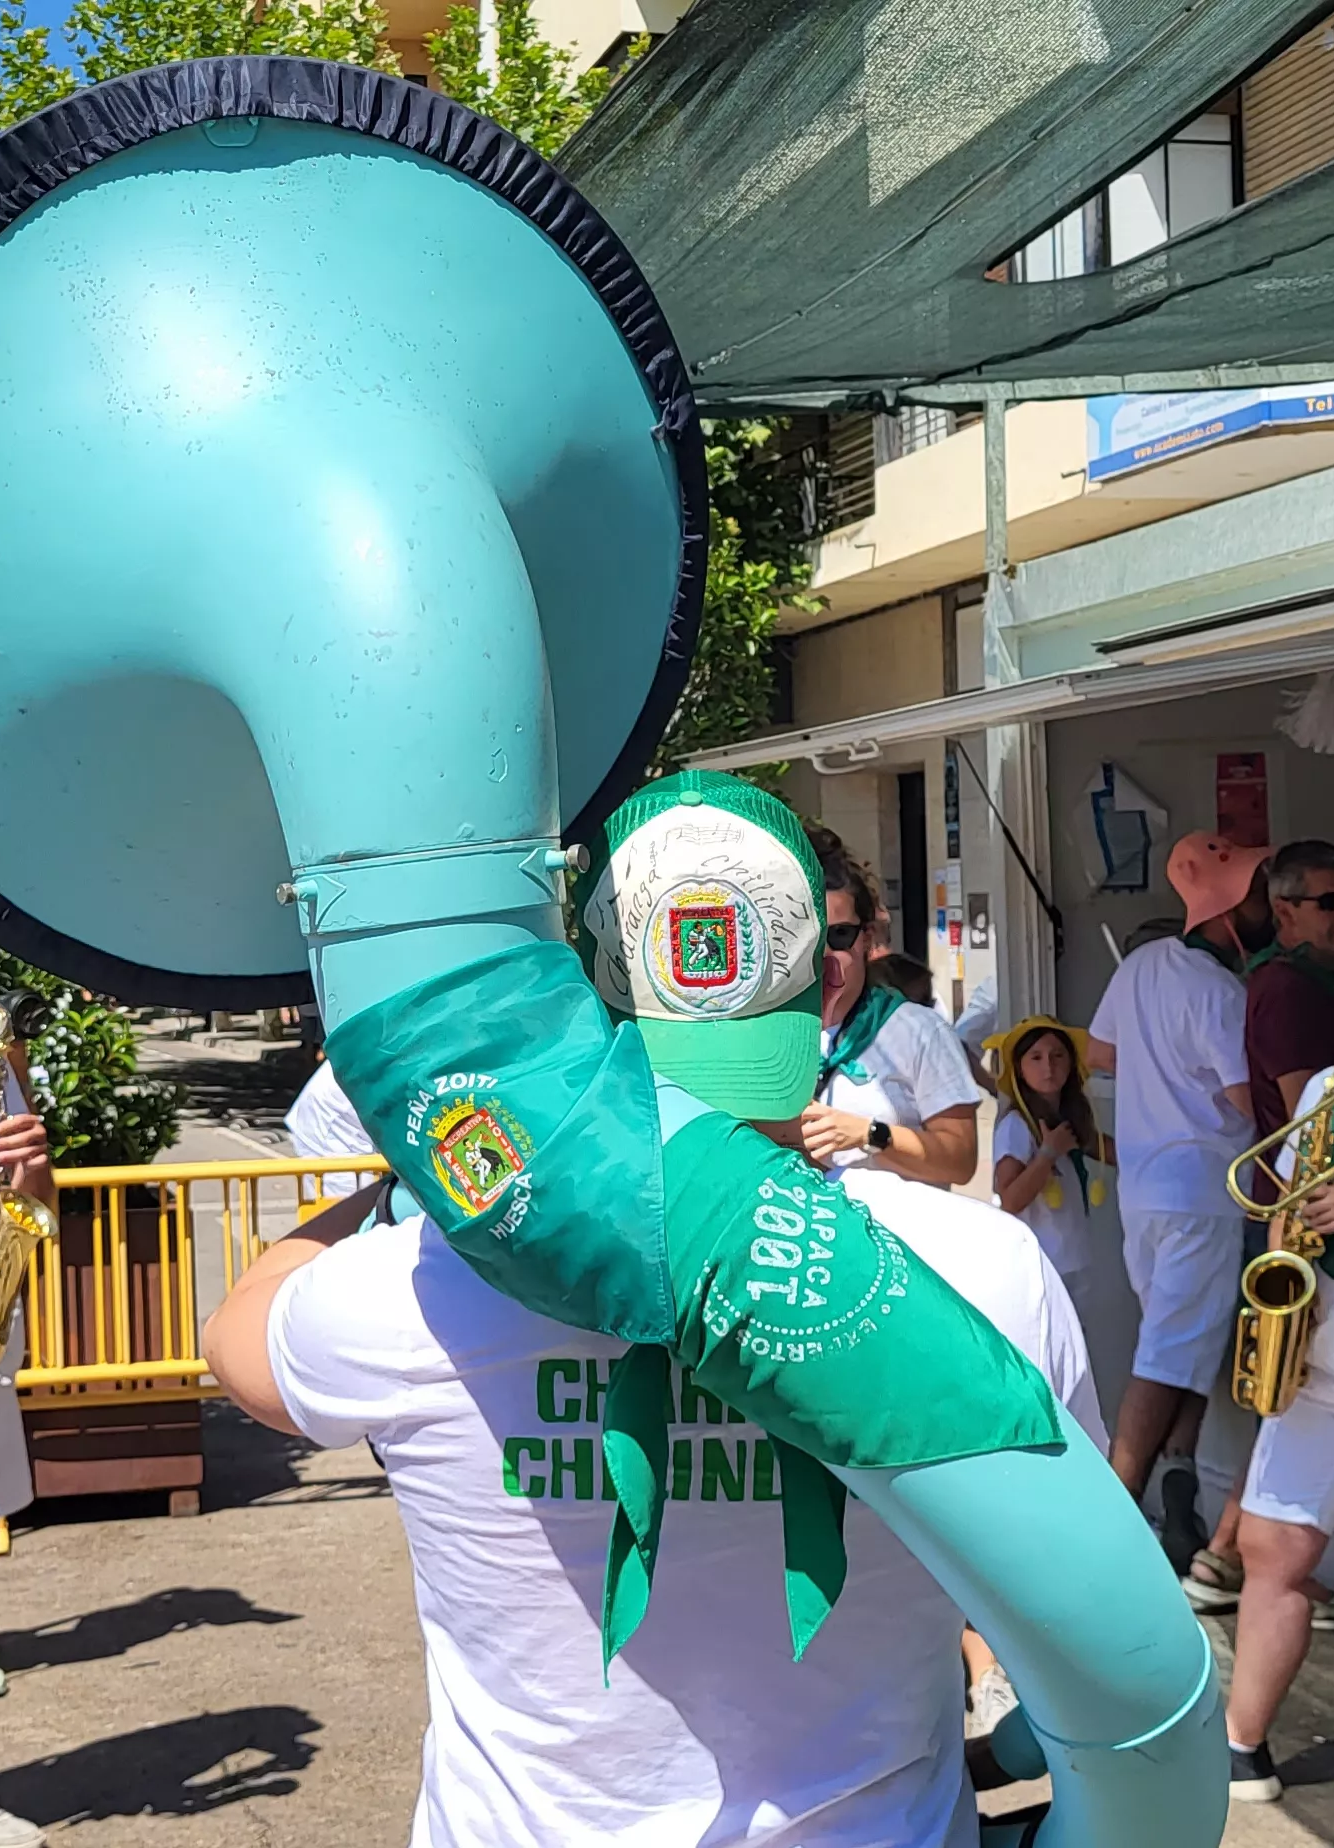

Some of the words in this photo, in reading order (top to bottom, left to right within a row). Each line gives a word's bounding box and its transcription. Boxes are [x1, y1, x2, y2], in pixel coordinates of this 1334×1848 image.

[407, 1089, 434, 1146] PEÑA
[434, 1072, 499, 1096] ZOITI
[488, 1172, 533, 1240] HUESCA
[746, 1177, 807, 1305] 100%
[872, 1219, 908, 1298] UESCA
